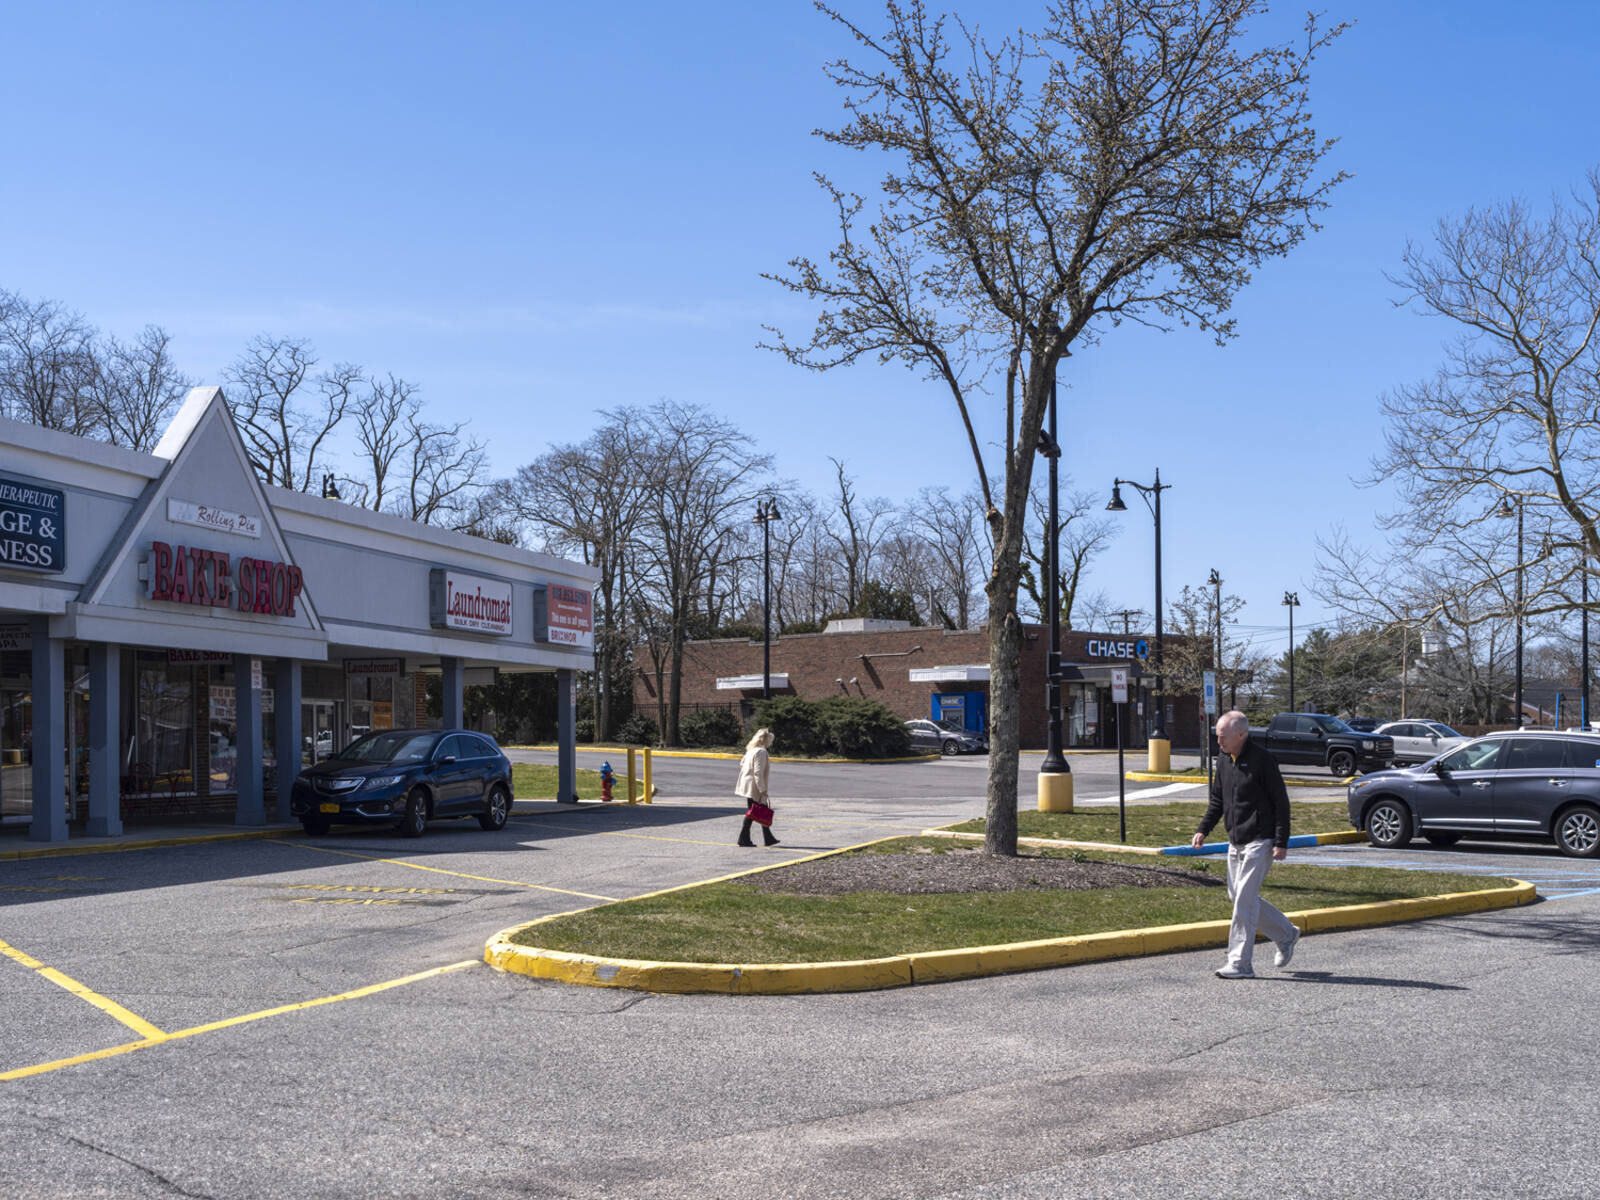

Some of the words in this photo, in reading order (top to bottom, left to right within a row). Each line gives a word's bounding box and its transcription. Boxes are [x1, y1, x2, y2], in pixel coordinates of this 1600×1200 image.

[0, 510, 32, 535] GE
[39, 517, 57, 539] &
[198, 505, 235, 533] Rolling
[238, 515, 256, 531] Pin
[152, 541, 231, 608] BAKE
[238, 556, 303, 617] SHOP
[447, 581, 511, 624] Laundromat
[169, 648, 200, 662] BAKE
[1088, 640, 1134, 659] CHASE
